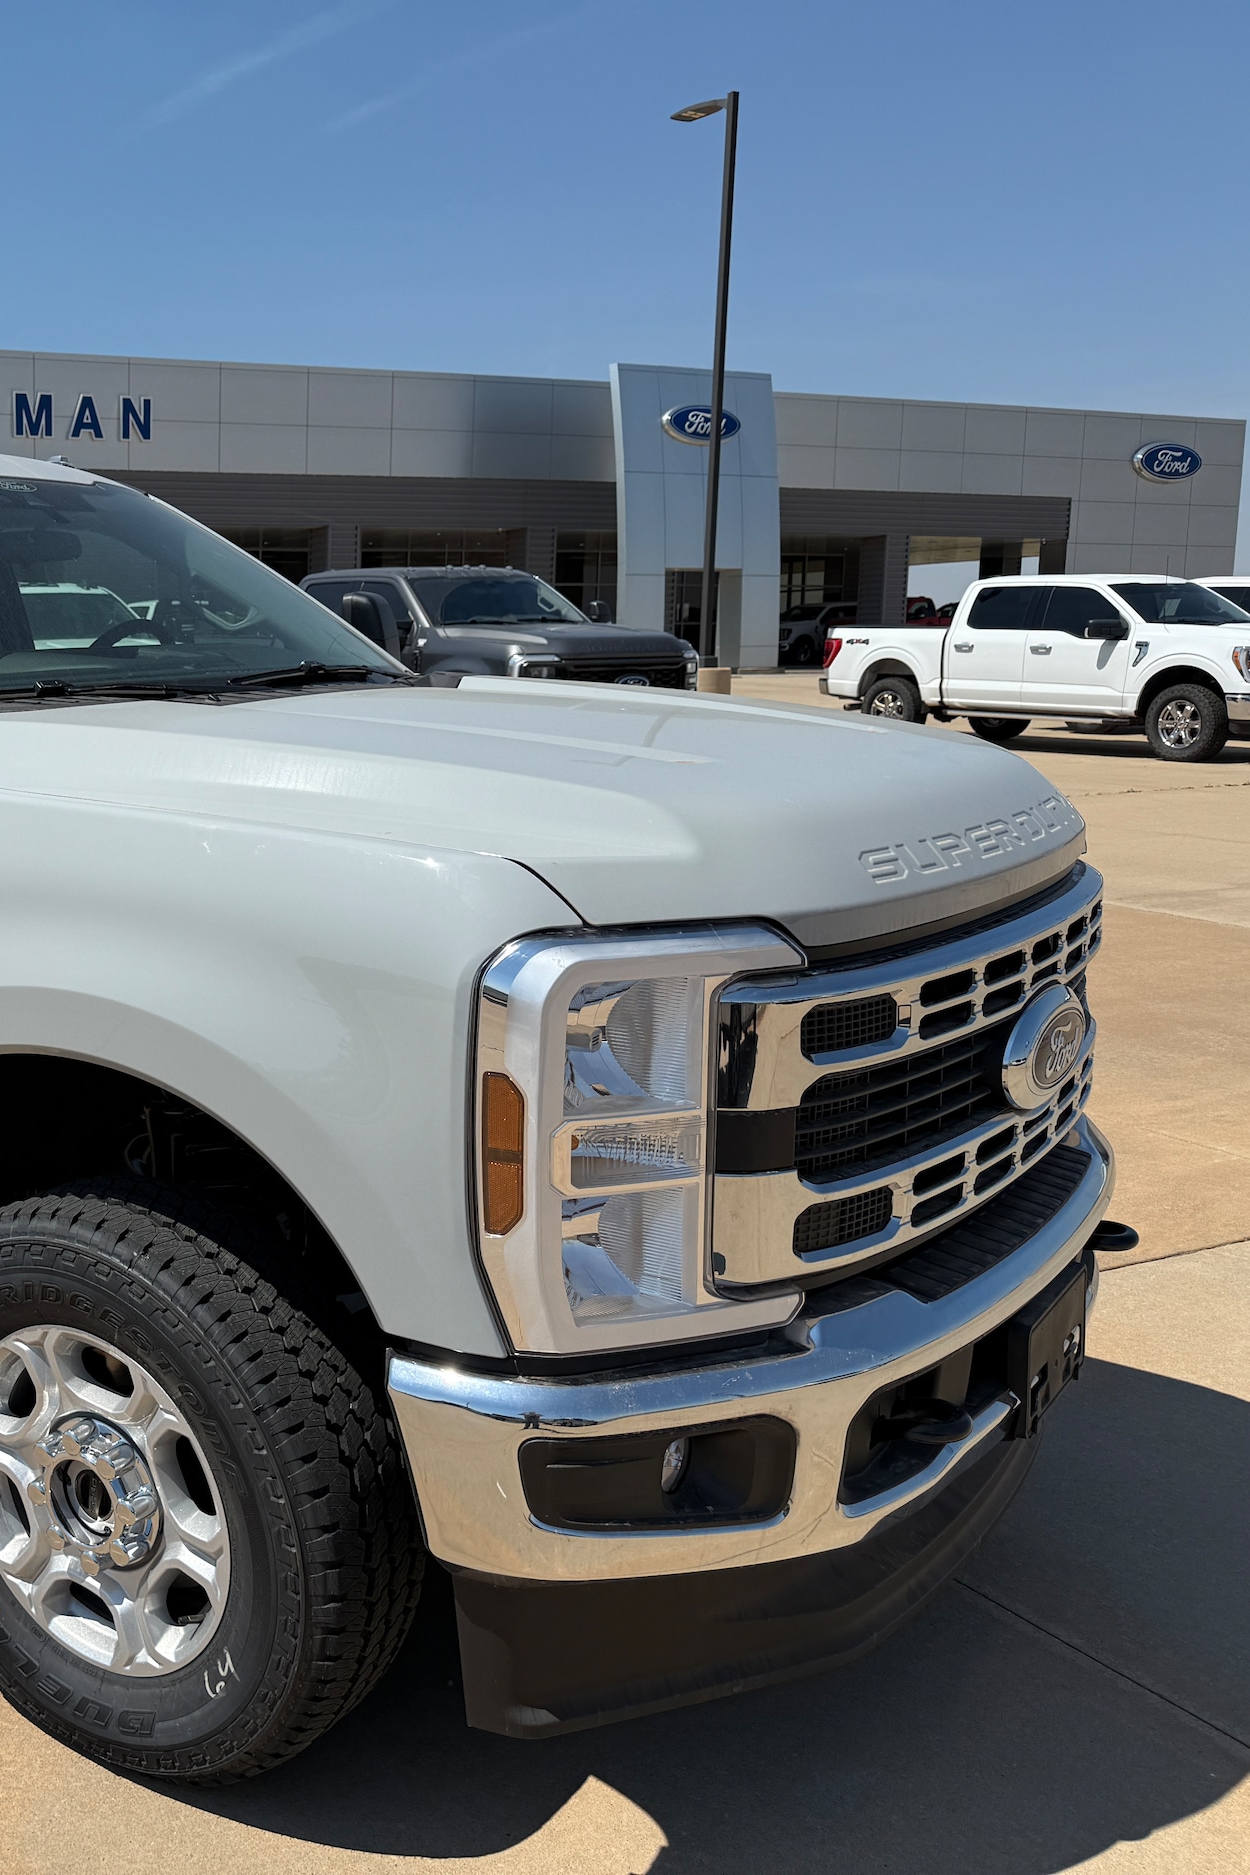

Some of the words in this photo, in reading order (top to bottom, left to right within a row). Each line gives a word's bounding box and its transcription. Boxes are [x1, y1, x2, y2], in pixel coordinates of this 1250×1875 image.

[1153, 449, 1192, 474] Ford
[858, 819, 1026, 885] SUPER
[1045, 1020, 1079, 1080] Ford
